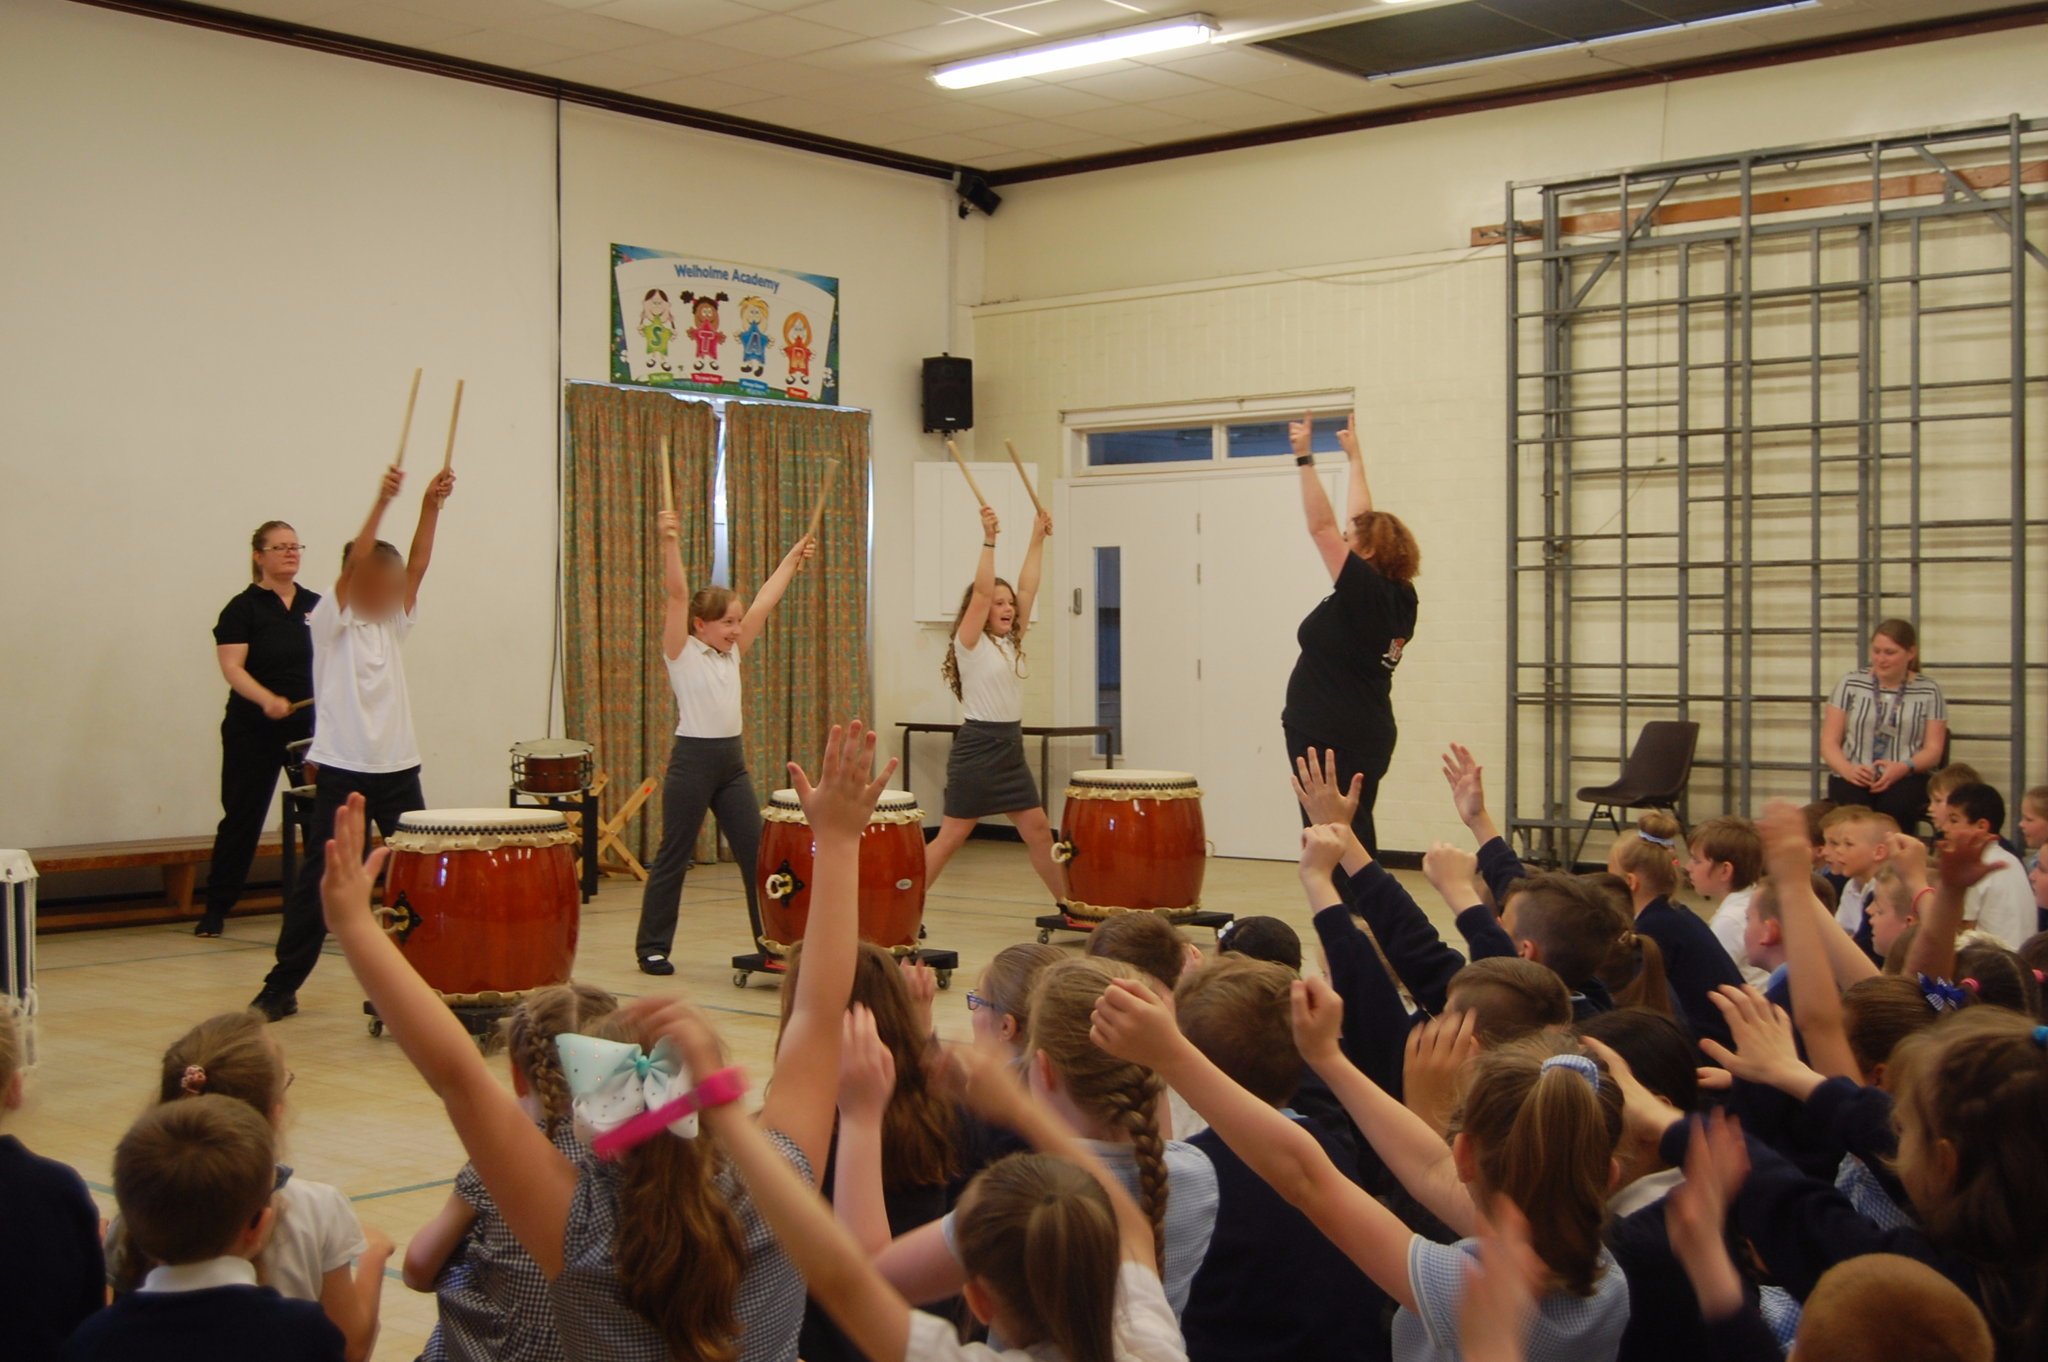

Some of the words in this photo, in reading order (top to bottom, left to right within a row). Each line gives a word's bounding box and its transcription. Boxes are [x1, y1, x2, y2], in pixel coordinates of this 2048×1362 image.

[674, 264, 729, 281] Welholme
[732, 269, 780, 294] Academy
[651, 327, 663, 348] S
[698, 330, 715, 353] T
[746, 332, 763, 355] A
[792, 346, 807, 369] R
